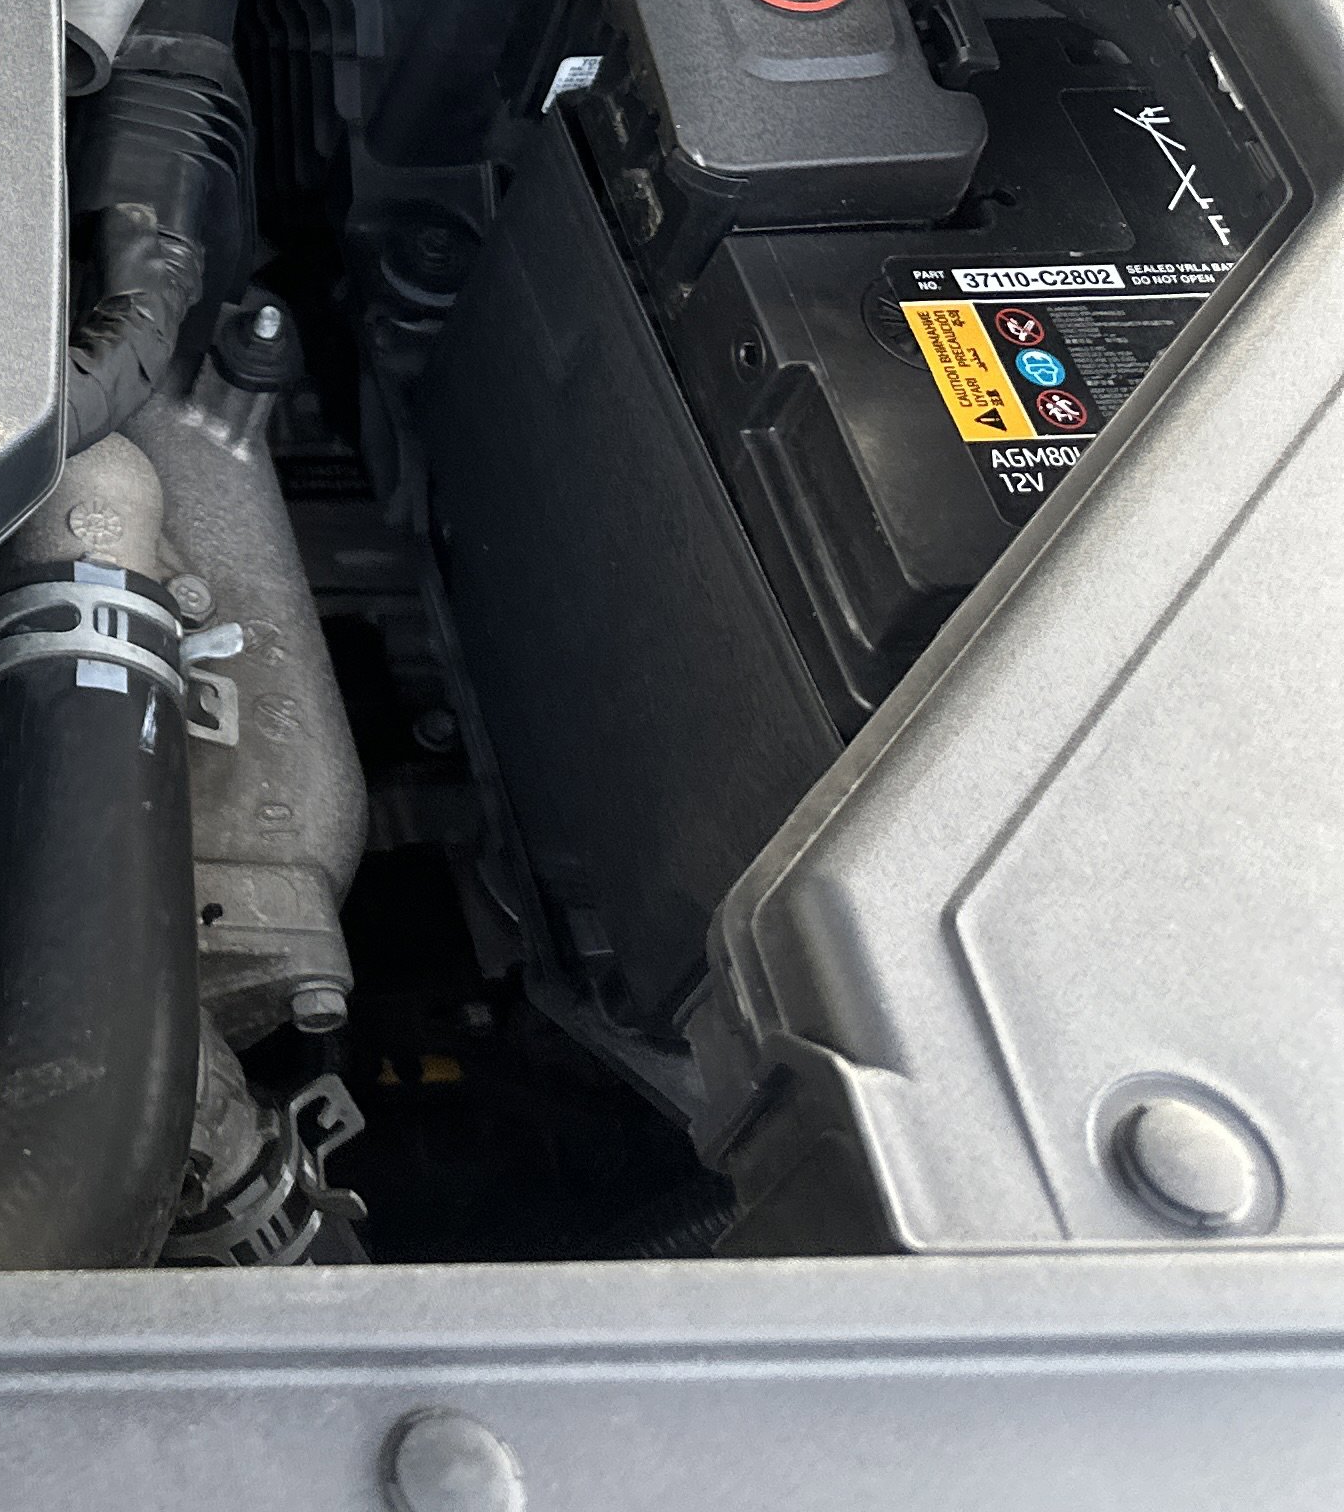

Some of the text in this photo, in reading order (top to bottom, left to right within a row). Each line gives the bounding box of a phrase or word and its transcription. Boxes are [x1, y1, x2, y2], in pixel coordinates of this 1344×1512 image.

[913, 270, 945, 281] PART
[1126, 263, 1174, 274] SEALED
[1175, 263, 1210, 273] VRLA
[962, 269, 1115, 289] 37110-C2802
[1132, 273, 1216, 285] DO NOT OPEN
[943, 365, 973, 408] CAUTION
[964, 377, 989, 407] UYARI
[998, 471, 1044, 494] 12V
